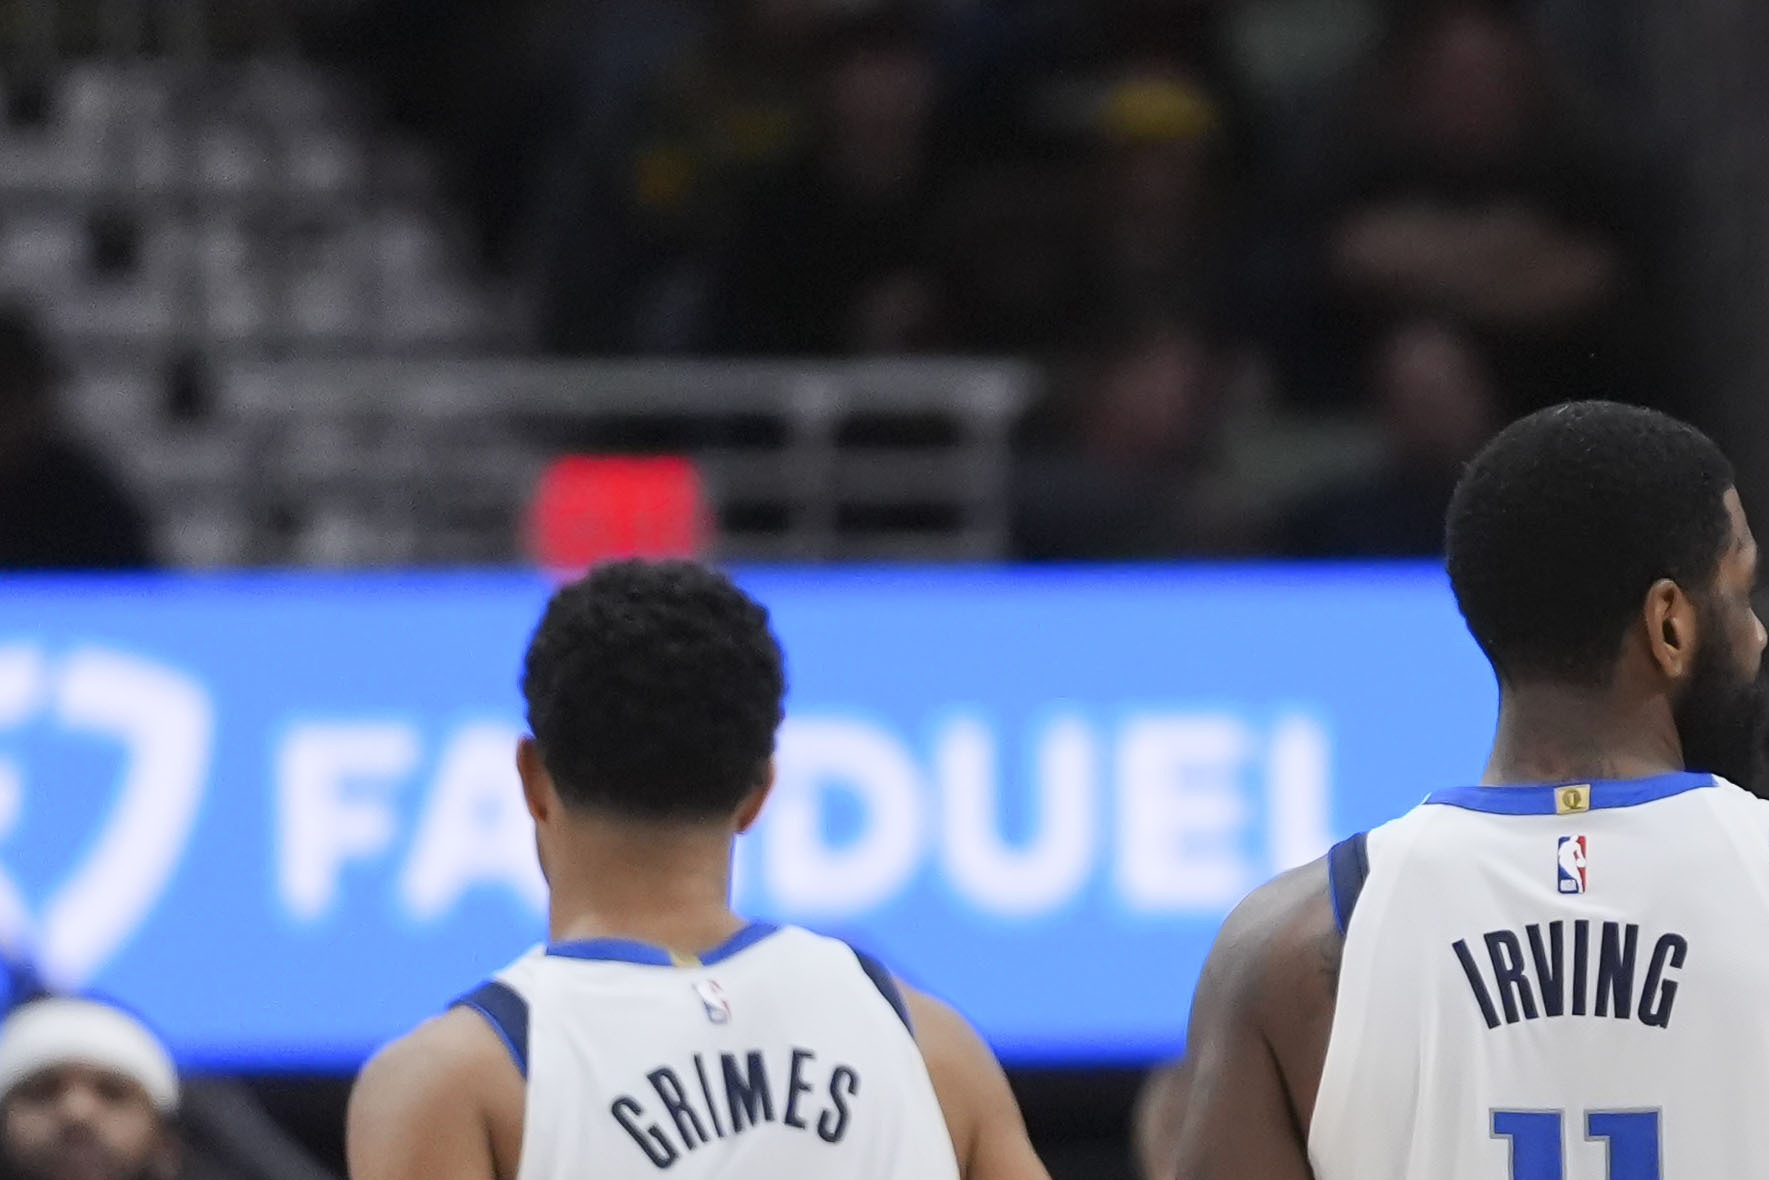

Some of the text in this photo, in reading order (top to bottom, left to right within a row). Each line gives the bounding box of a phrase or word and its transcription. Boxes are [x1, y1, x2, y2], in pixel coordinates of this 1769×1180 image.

[277, 710, 1328, 916] FADUEL
[1451, 919, 1688, 1030] IRVING
[611, 1046, 861, 1169] GRIMES
